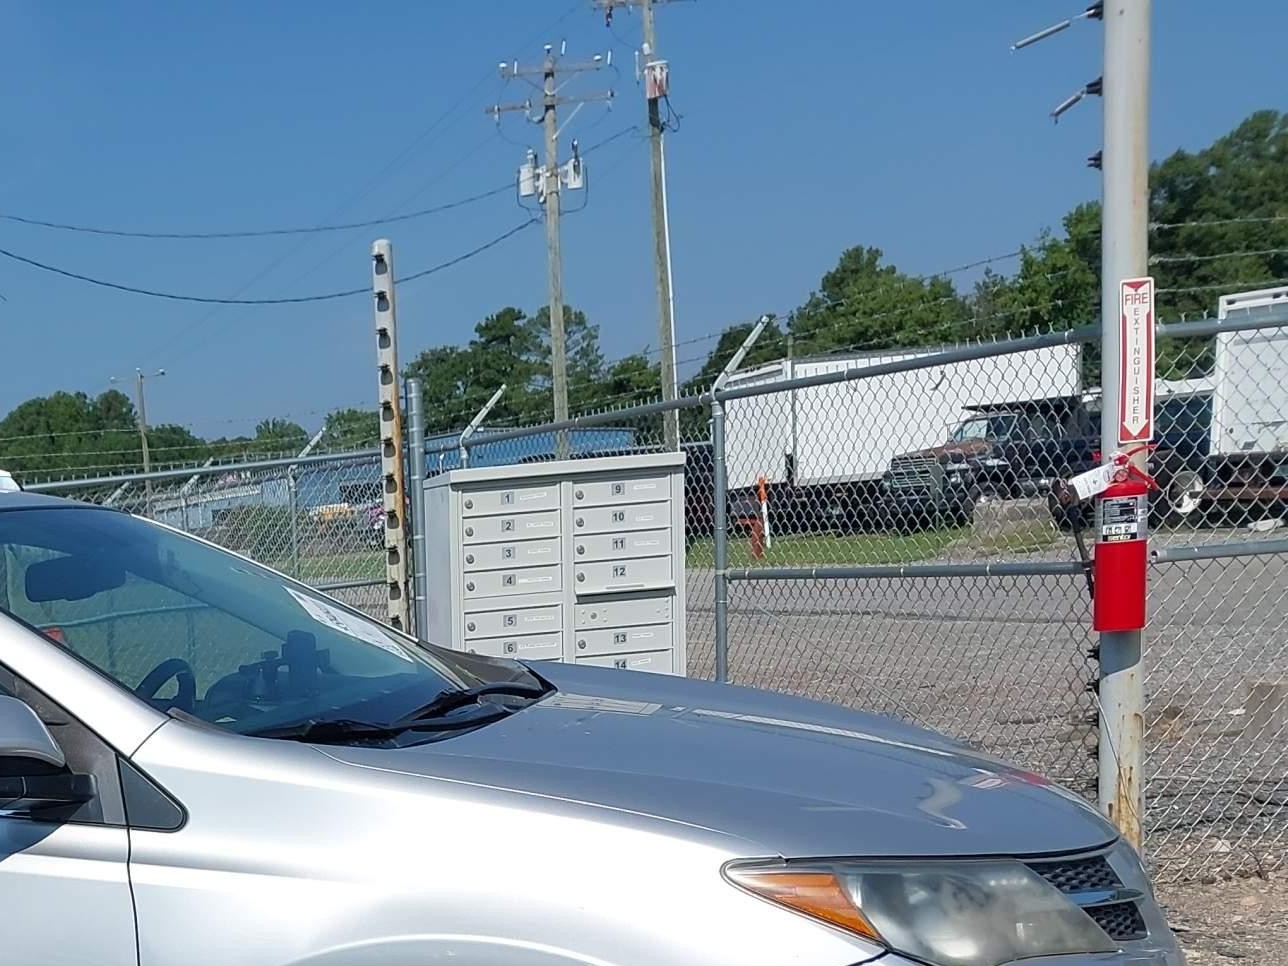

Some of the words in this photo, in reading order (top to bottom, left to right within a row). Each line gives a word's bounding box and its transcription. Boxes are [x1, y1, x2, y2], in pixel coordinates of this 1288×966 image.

[1125, 292, 1149, 306] FIRE
[1132, 307, 1141, 425] EXTINGUISHER
[615, 484, 621, 494] 9
[505, 494, 510, 504] 1
[612, 511, 625, 522] 10
[505, 521, 512, 531] 2
[613, 539, 624, 549] 11
[505, 549, 512, 558] 3
[614, 567, 626, 577] 12
[506, 575, 513, 585] 4
[507, 616, 514, 626] 5
[615, 634, 627, 643] 13
[507, 643, 514, 653] 6
[615, 661, 627, 670] 14
